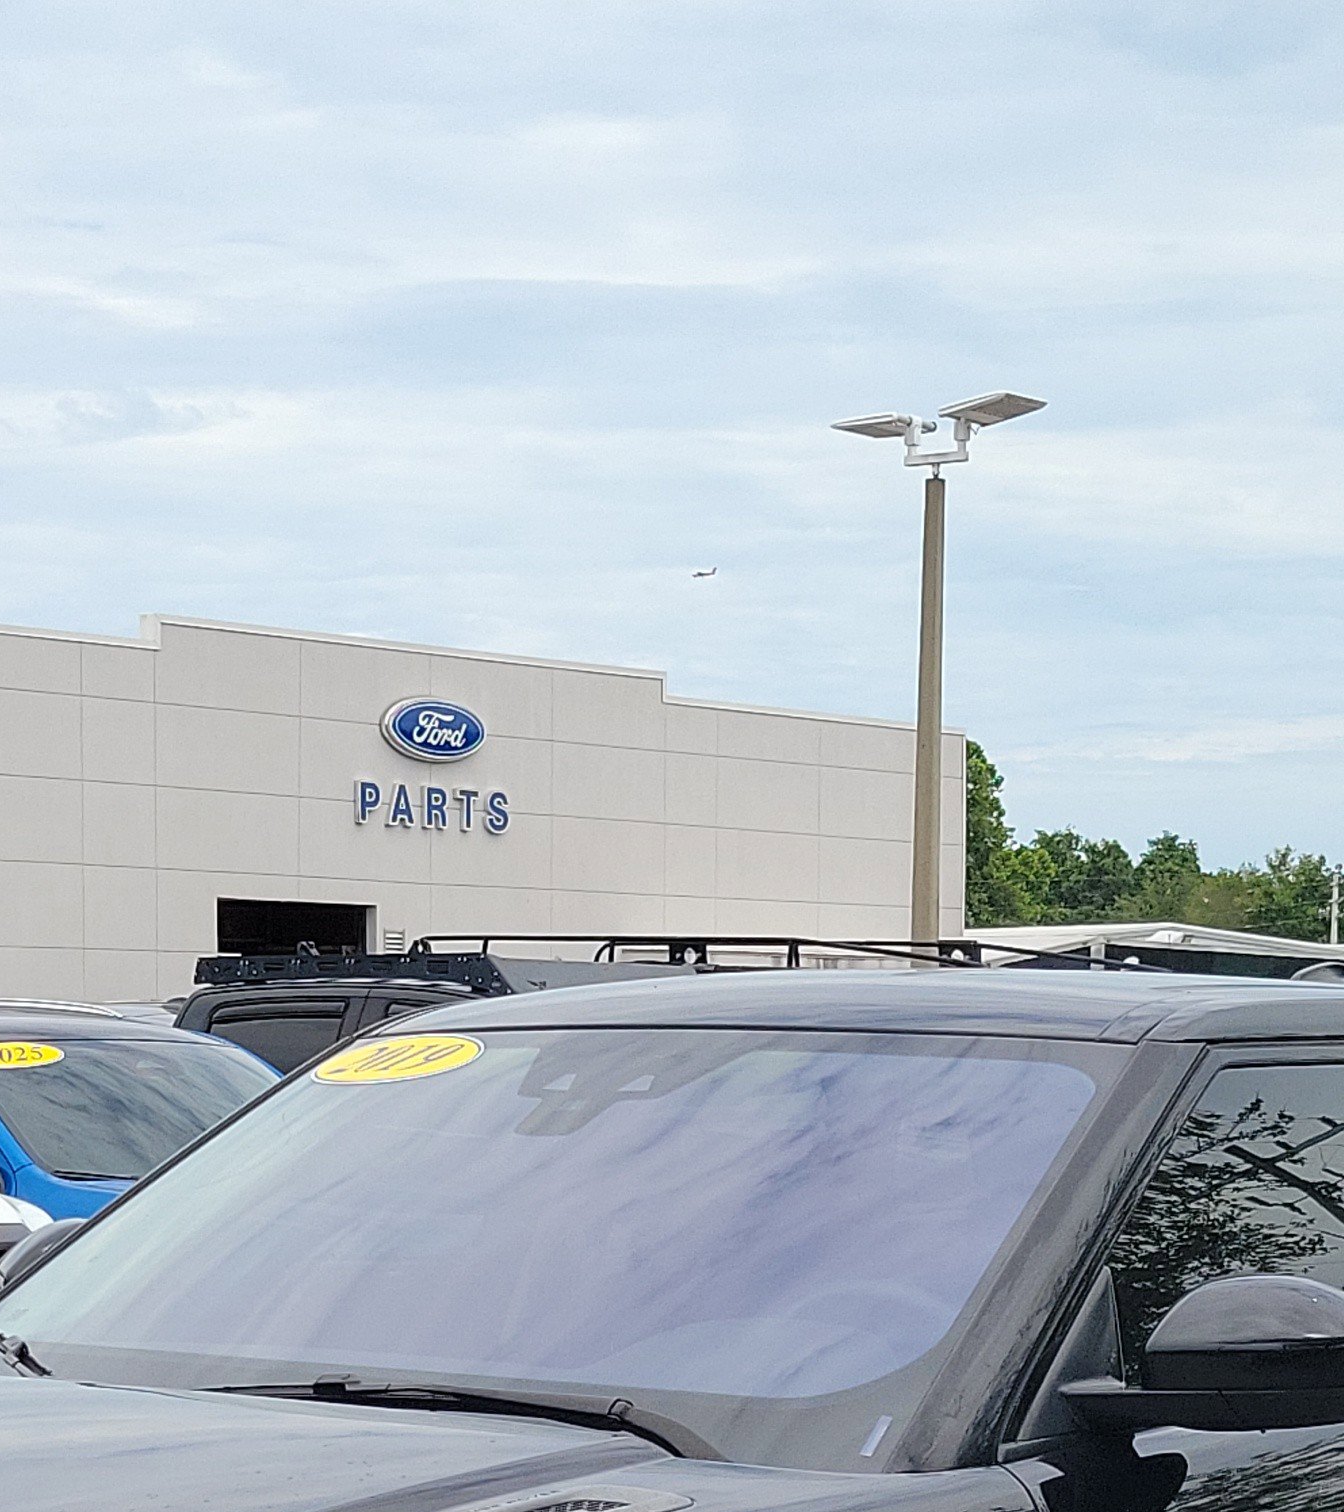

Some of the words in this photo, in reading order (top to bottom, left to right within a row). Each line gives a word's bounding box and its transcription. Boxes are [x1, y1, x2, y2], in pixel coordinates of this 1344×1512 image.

[412, 710, 467, 748] Ford
[354, 779, 511, 835] PARTS
[326, 1043, 465, 1075] 2019
